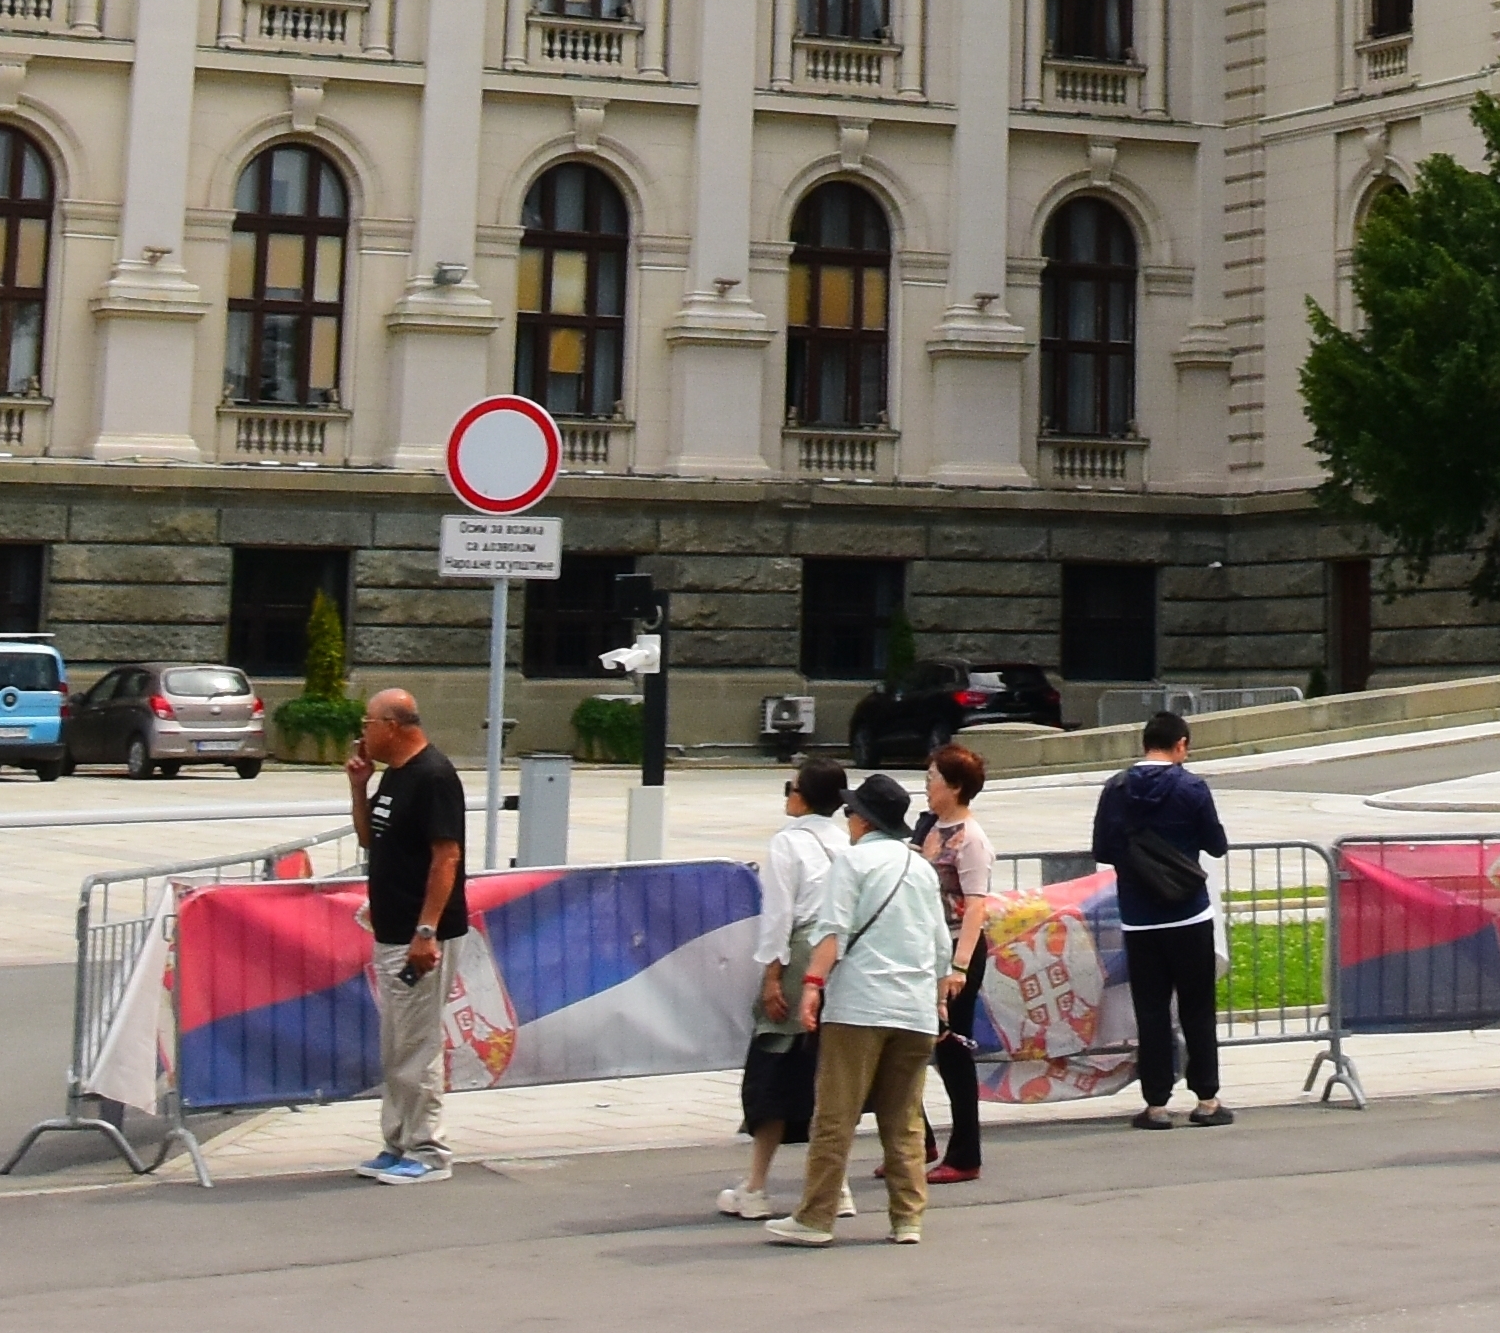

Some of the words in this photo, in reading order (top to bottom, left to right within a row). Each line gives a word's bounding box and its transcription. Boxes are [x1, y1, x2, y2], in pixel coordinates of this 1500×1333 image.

[460, 520, 487, 533] Осим
[490, 524, 503, 534] за
[506, 524, 544, 535] возила
[466, 541, 479, 551] са
[481, 542, 536, 552] дозволом
[445, 556, 492, 571] Народне
[495, 560, 555, 573] скупштине
